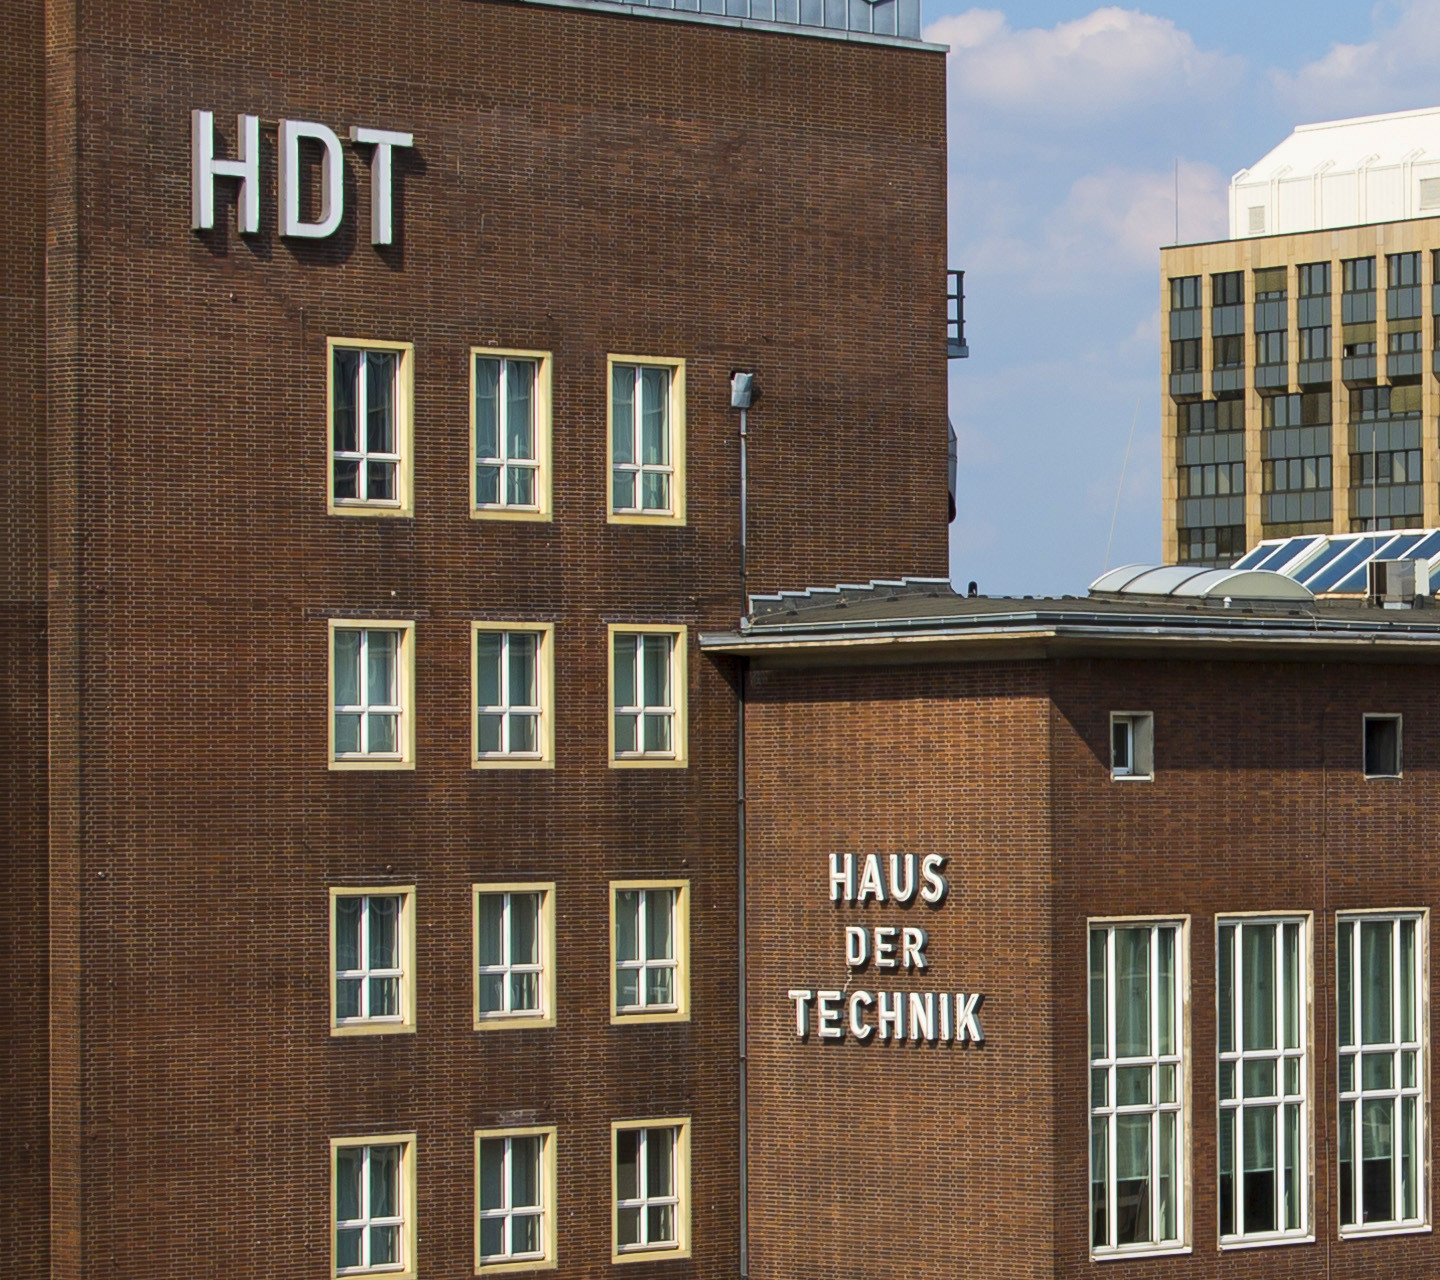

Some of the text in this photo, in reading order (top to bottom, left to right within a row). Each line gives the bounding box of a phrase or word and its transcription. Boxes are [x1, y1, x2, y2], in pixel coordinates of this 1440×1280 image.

[191, 109, 414, 245] HDT
[828, 853, 949, 904] HAUS
[845, 925, 929, 968] DER
[788, 989, 985, 1042] TECHNIK
